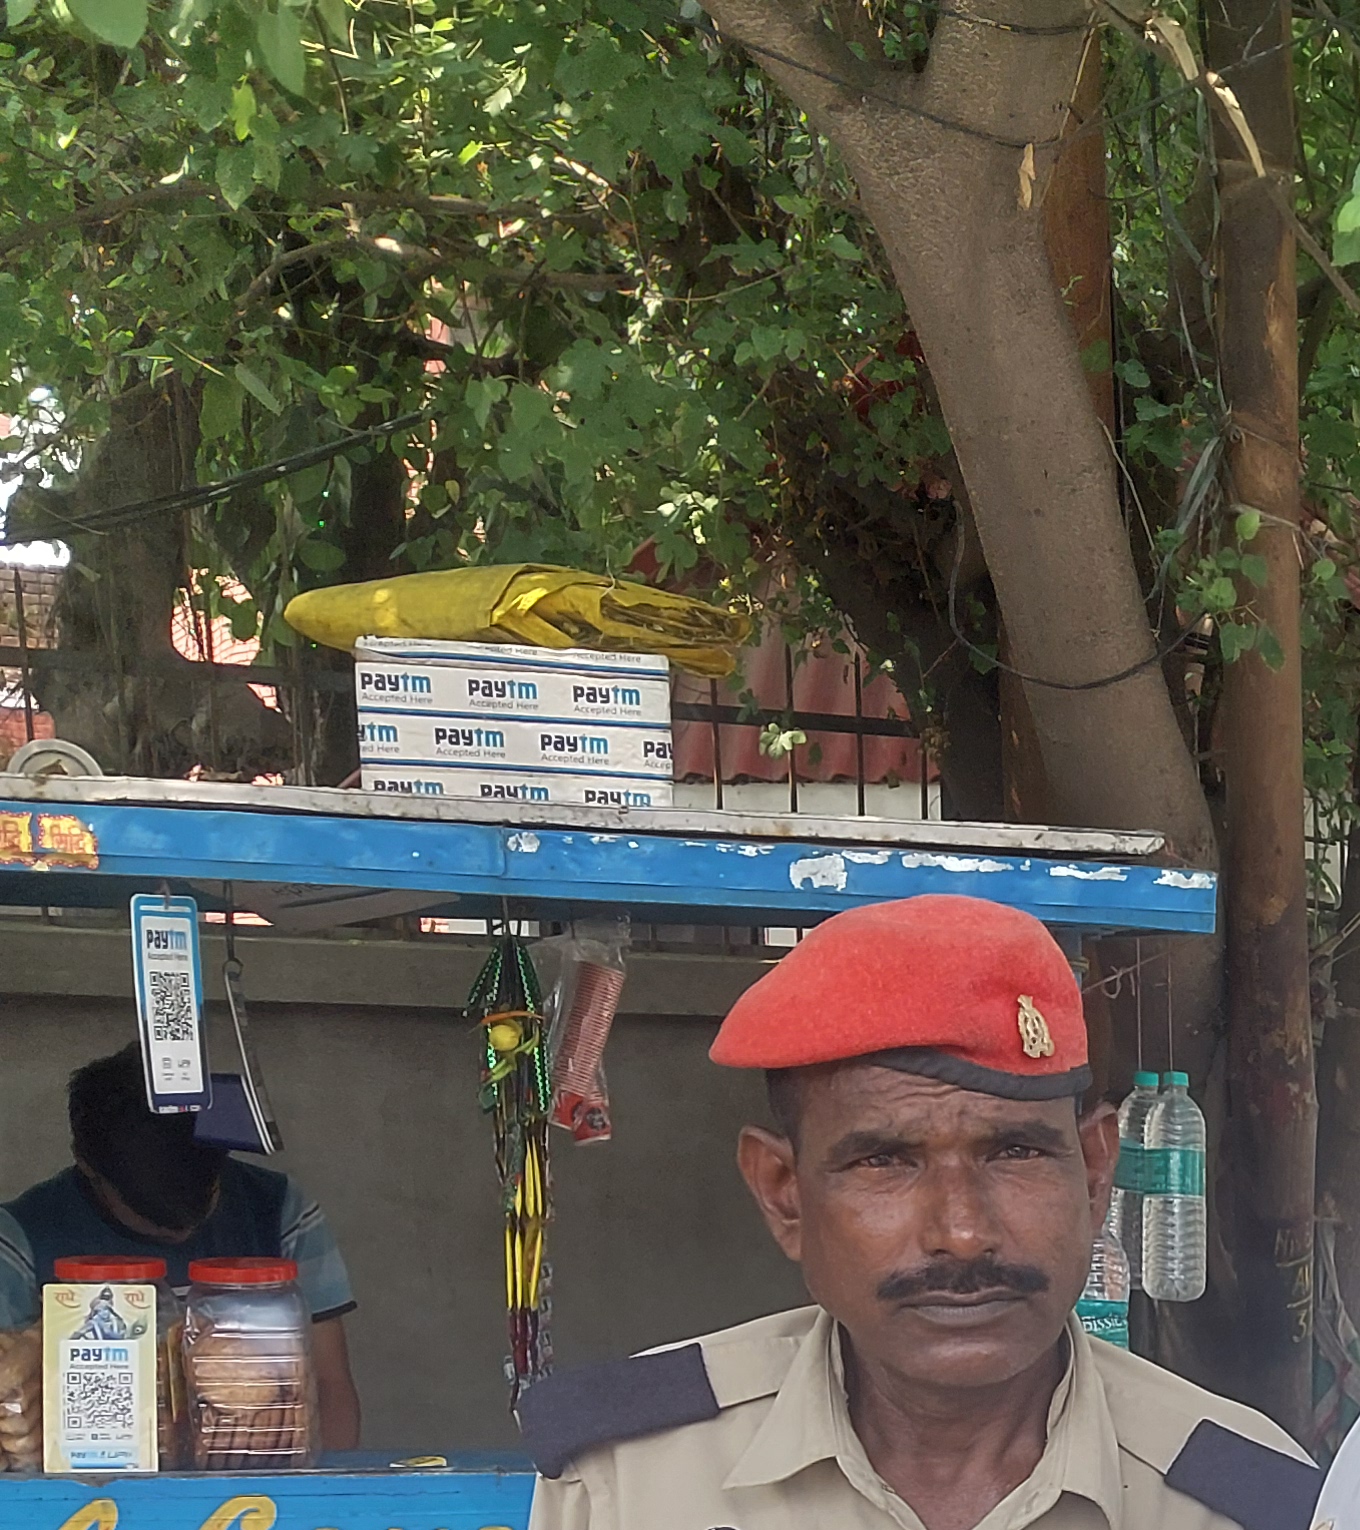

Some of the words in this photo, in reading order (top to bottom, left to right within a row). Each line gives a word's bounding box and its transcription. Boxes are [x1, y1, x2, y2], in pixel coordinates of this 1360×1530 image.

[362, 693, 406, 703] Accepted
[410, 695, 433, 704] Here
[470, 699, 513, 709] Accepted
[517, 702, 539, 710] Here
[574, 705, 616, 716] Accepted
[620, 707, 642, 716] Here
[377, 745, 400, 753] Here
[436, 747, 480, 758] Accepted
[484, 750, 505, 758] Here
[541, 754, 584, 764] Accepted
[588, 757, 609, 765] Here
